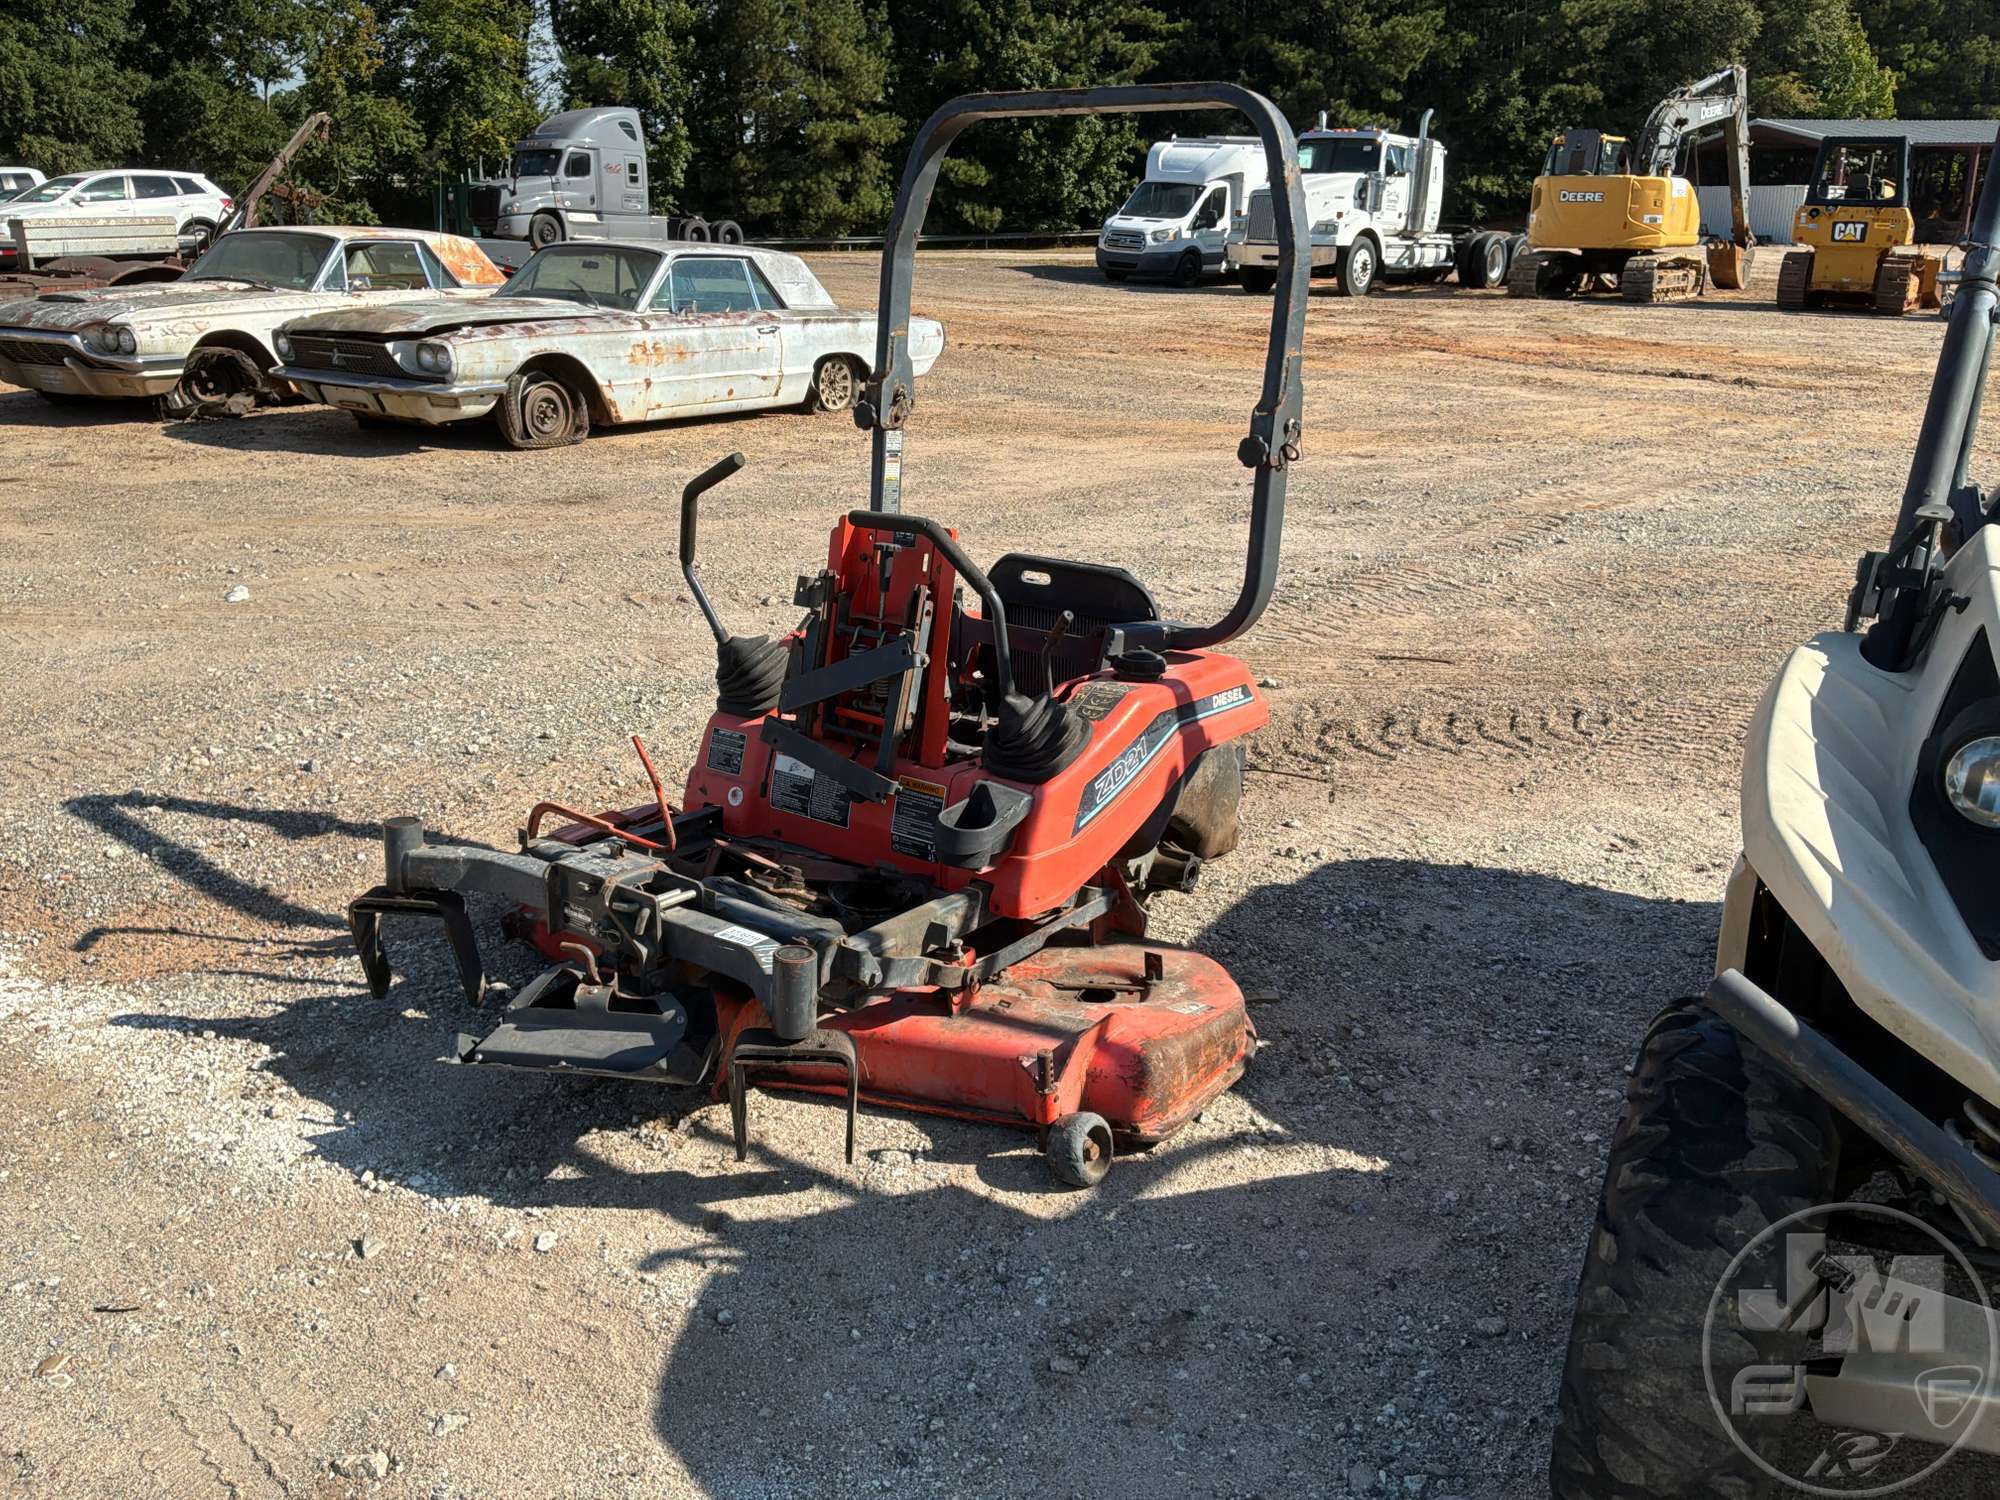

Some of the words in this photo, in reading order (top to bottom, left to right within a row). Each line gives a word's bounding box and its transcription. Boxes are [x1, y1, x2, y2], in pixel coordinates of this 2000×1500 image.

[1700, 103, 1724, 121] DEERE
[1559, 189, 1605, 202] DEERE
[1833, 222, 1865, 241] CAT
[1212, 686, 1245, 709] DIESEL
[1094, 735, 1148, 804] ZD21
